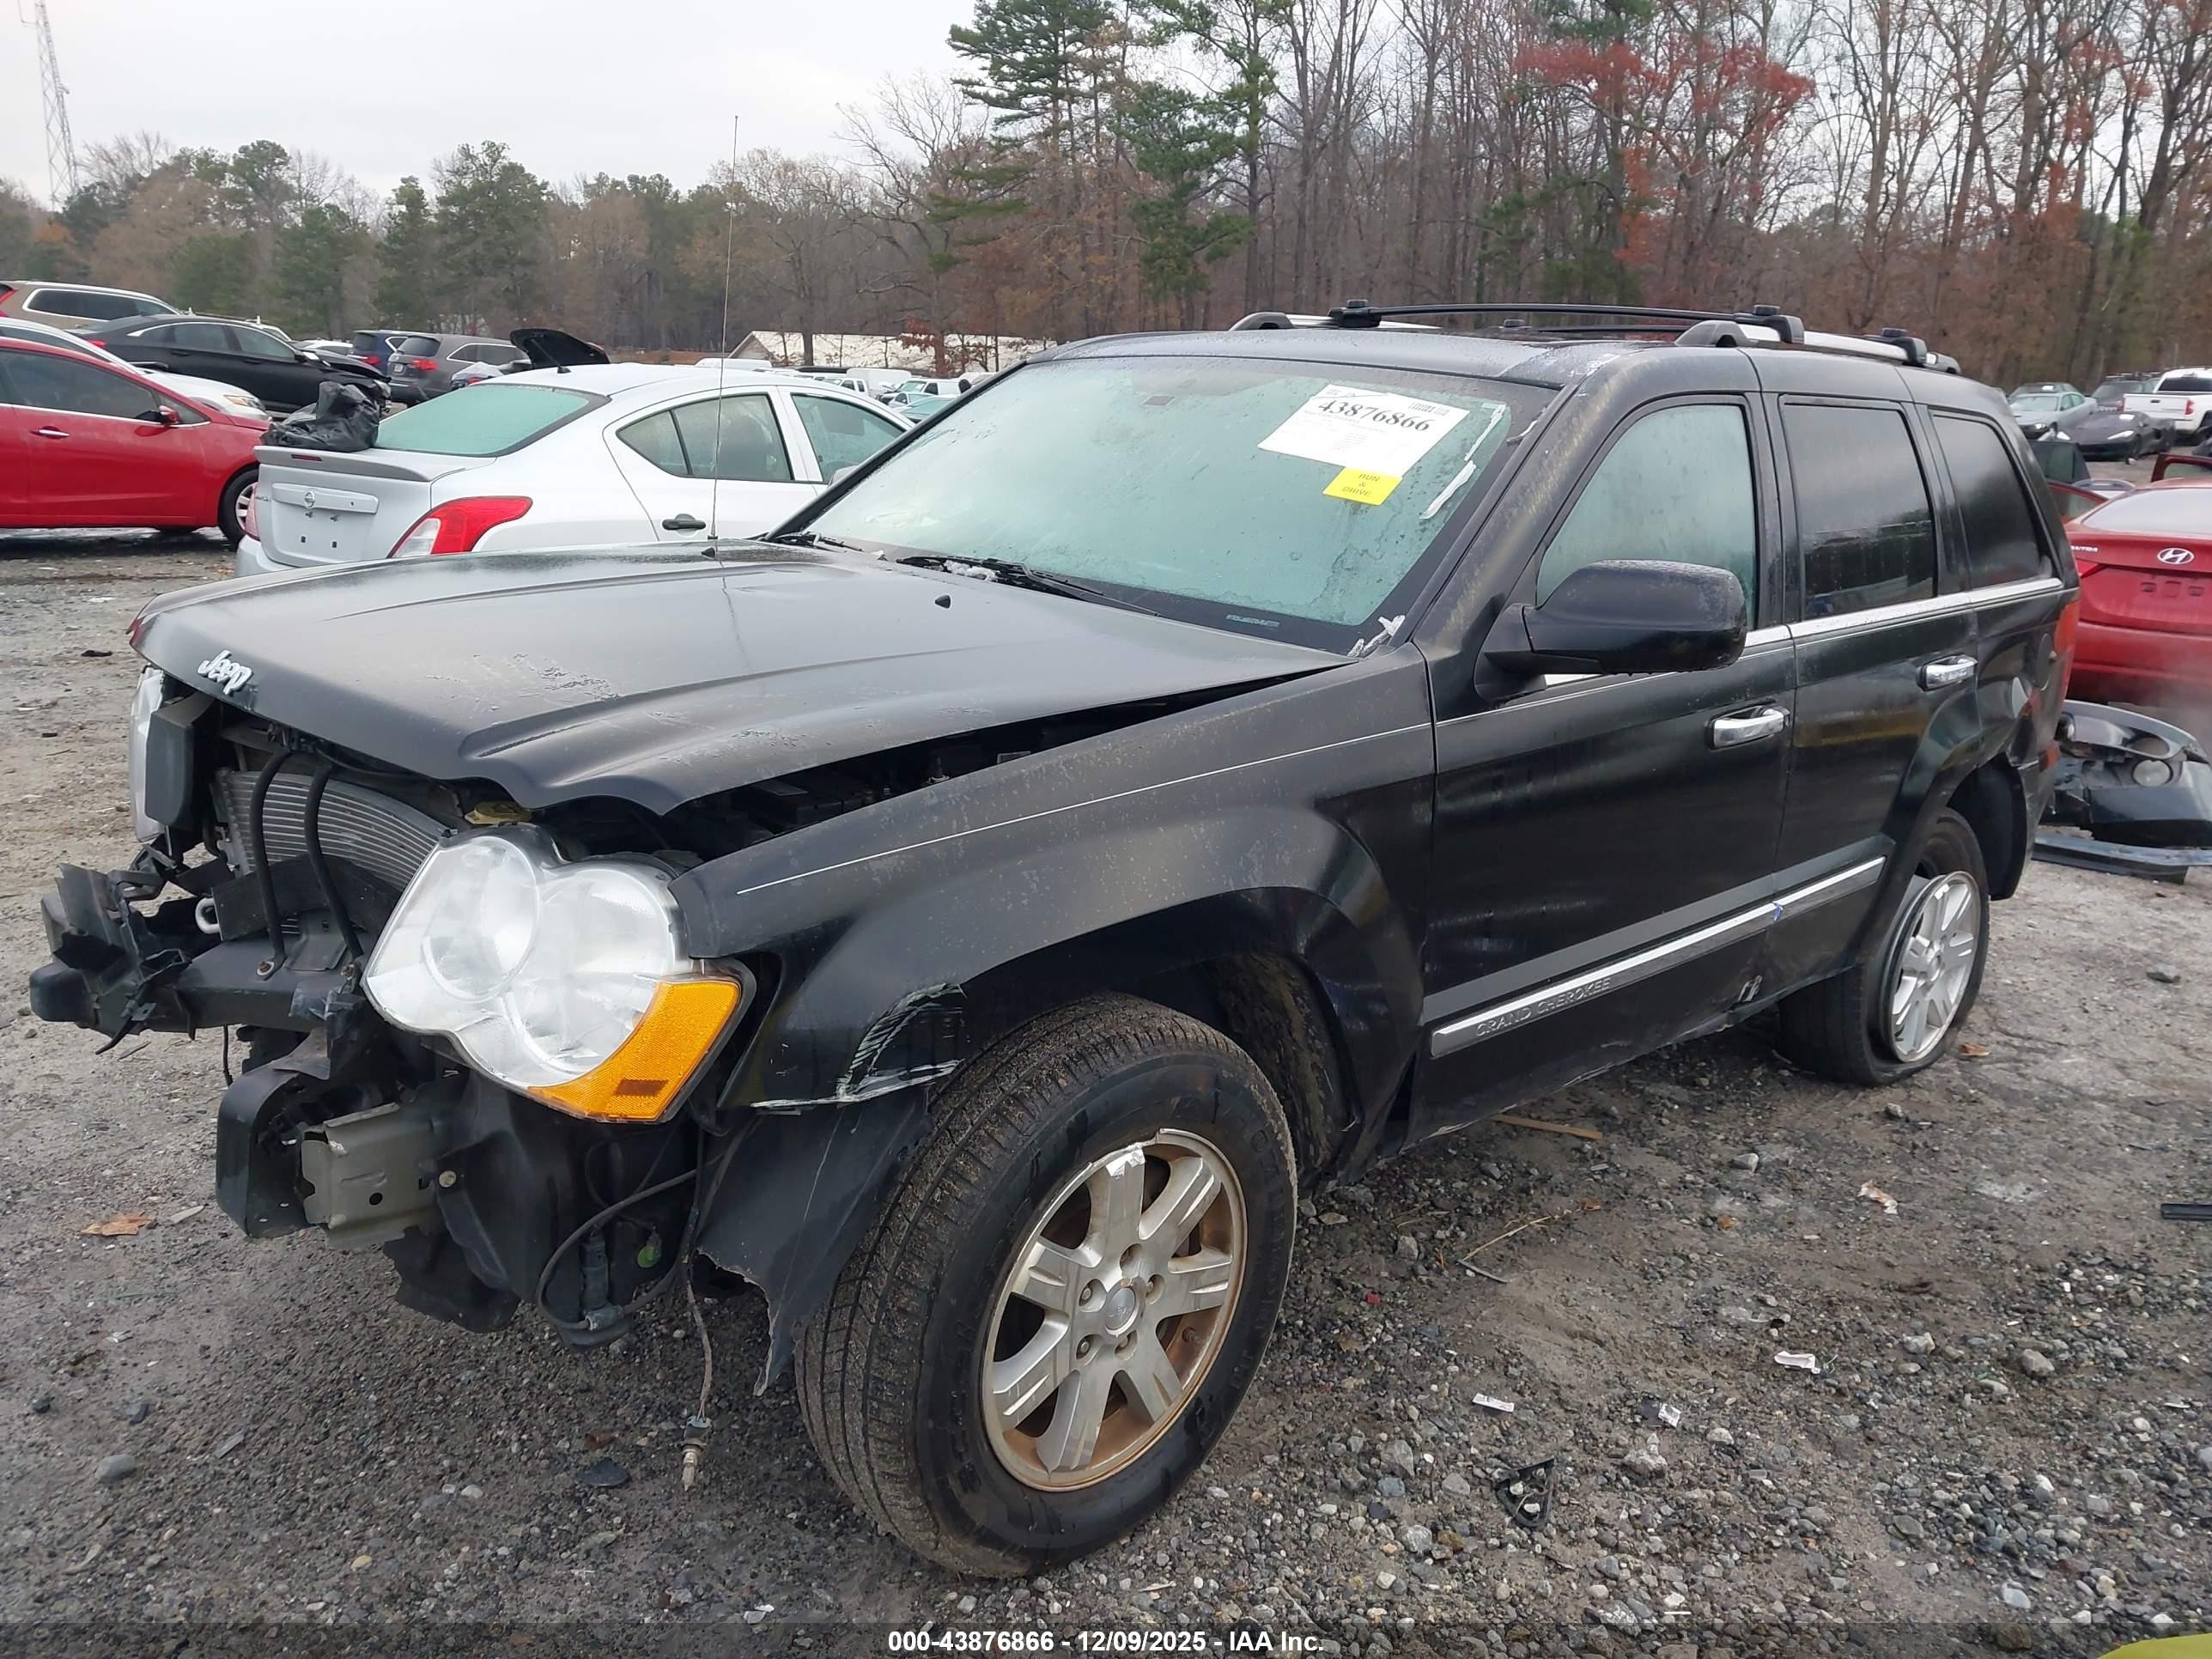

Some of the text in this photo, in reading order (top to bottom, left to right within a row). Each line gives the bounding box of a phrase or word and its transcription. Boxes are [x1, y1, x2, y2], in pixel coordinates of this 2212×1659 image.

[1318, 399, 1436, 431] 43876866
[1341, 486, 1373, 497] DRIVE
[1358, 473, 1381, 483] RUN
[198, 649, 252, 696] Jeep
[1476, 977, 1612, 1036] GRAND CHEROKEE
